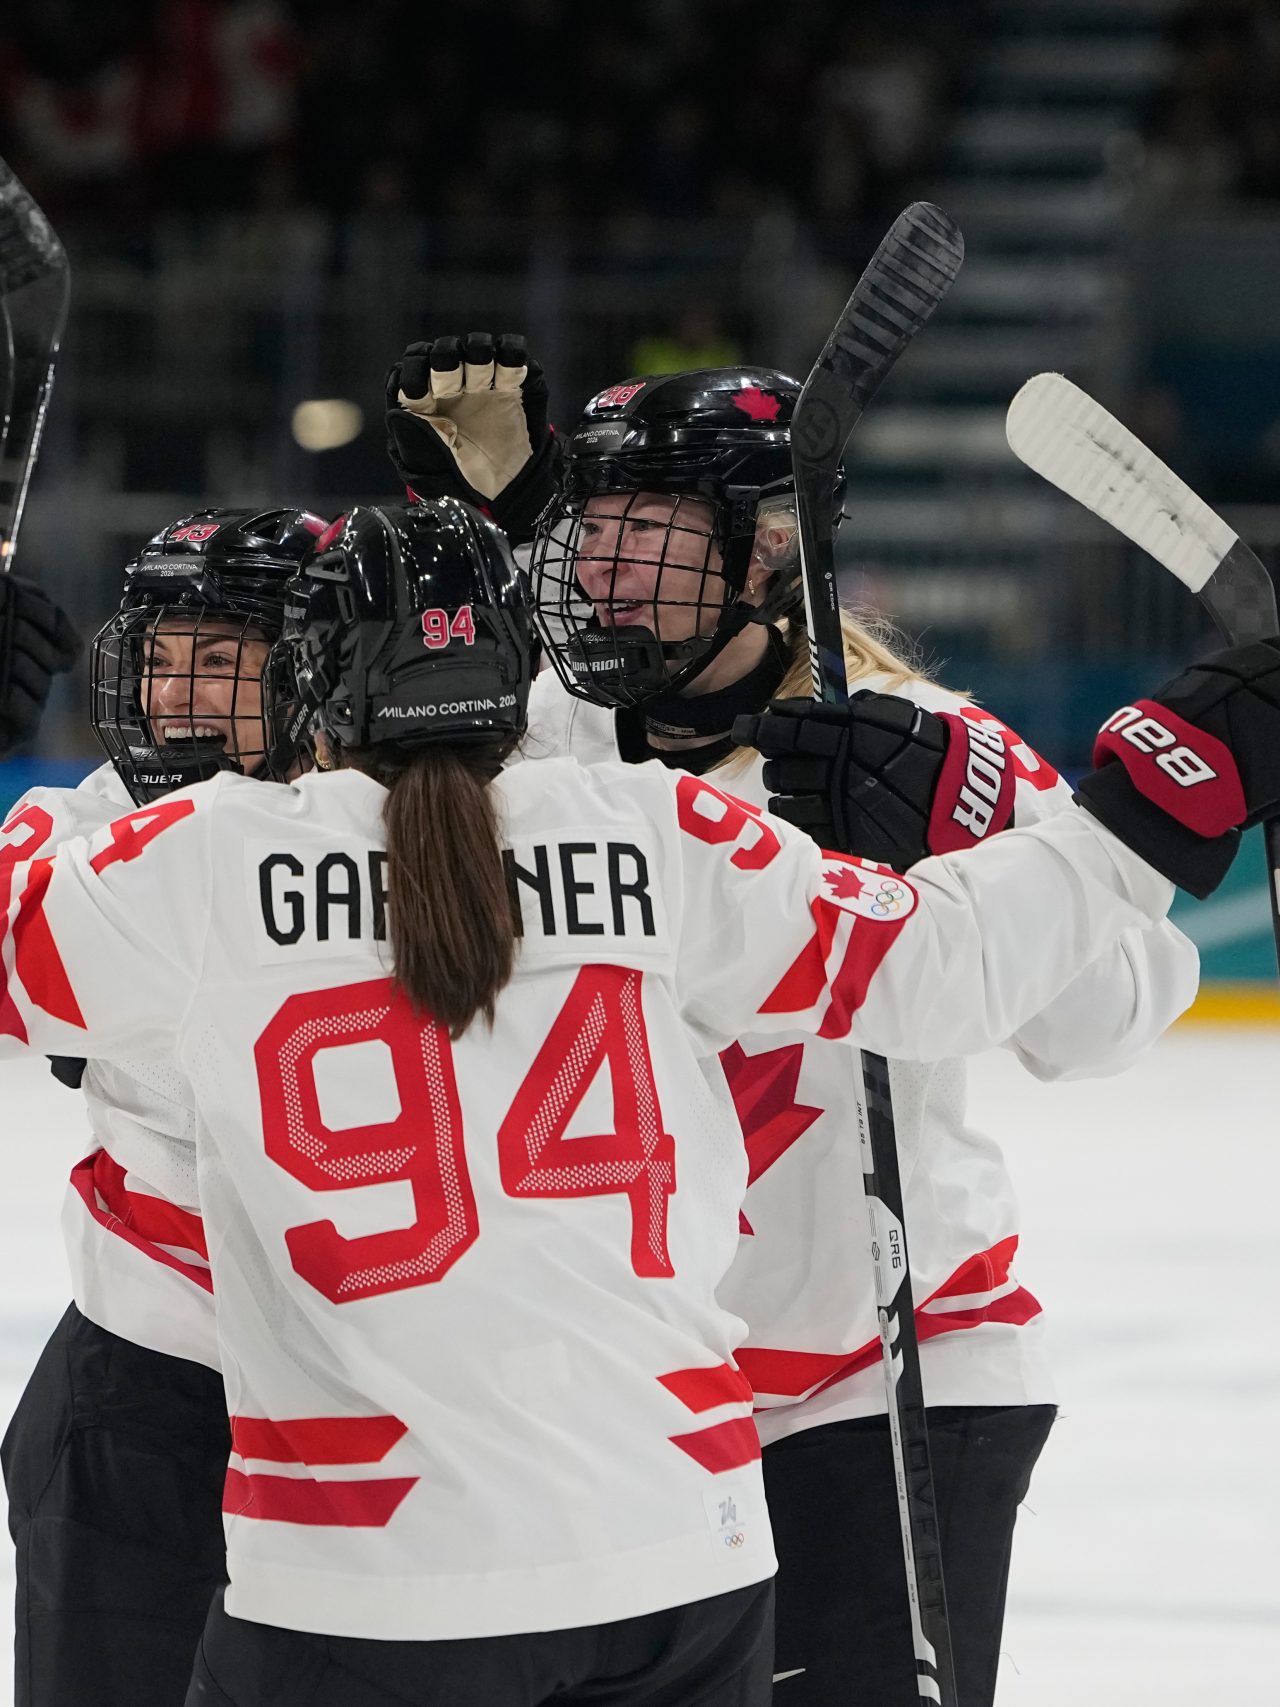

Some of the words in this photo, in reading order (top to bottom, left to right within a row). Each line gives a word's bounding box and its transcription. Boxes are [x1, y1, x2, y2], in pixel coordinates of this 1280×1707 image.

[573, 430, 594, 440] MILANO
[594, 429, 620, 437] CORTINA
[170, 524, 220, 541] 43
[422, 606, 475, 649] 94
[289, 703, 310, 743] BAUER
[377, 704, 437, 718] MILANO
[439, 699, 497, 715] CORTINA
[952, 716, 1006, 838] RIOR
[89, 799, 196, 876] 4
[258, 842, 657, 946] GANER
[253, 963, 677, 1305] 94
